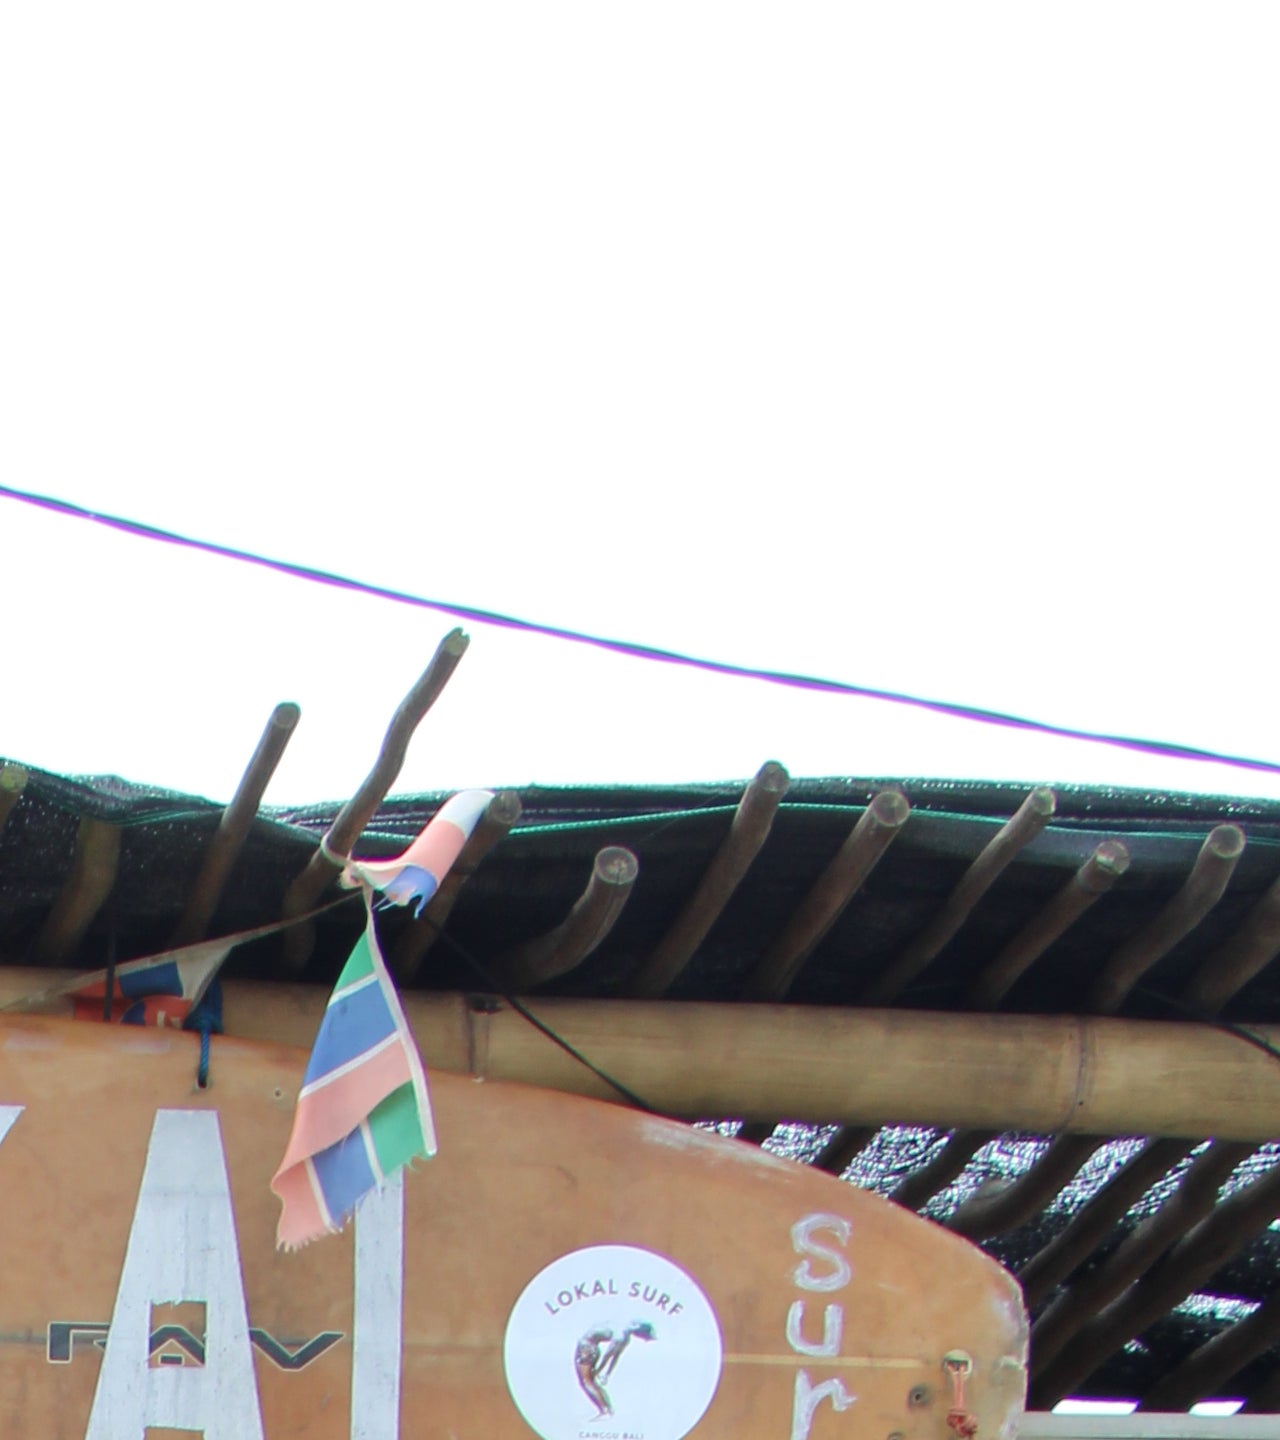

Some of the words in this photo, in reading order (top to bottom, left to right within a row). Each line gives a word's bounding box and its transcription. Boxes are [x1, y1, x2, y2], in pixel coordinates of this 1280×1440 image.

[544, 1278, 619, 1316] LOKAL
[628, 1281, 685, 1317] SURF
[622, 1431, 645, 1440] BALI
